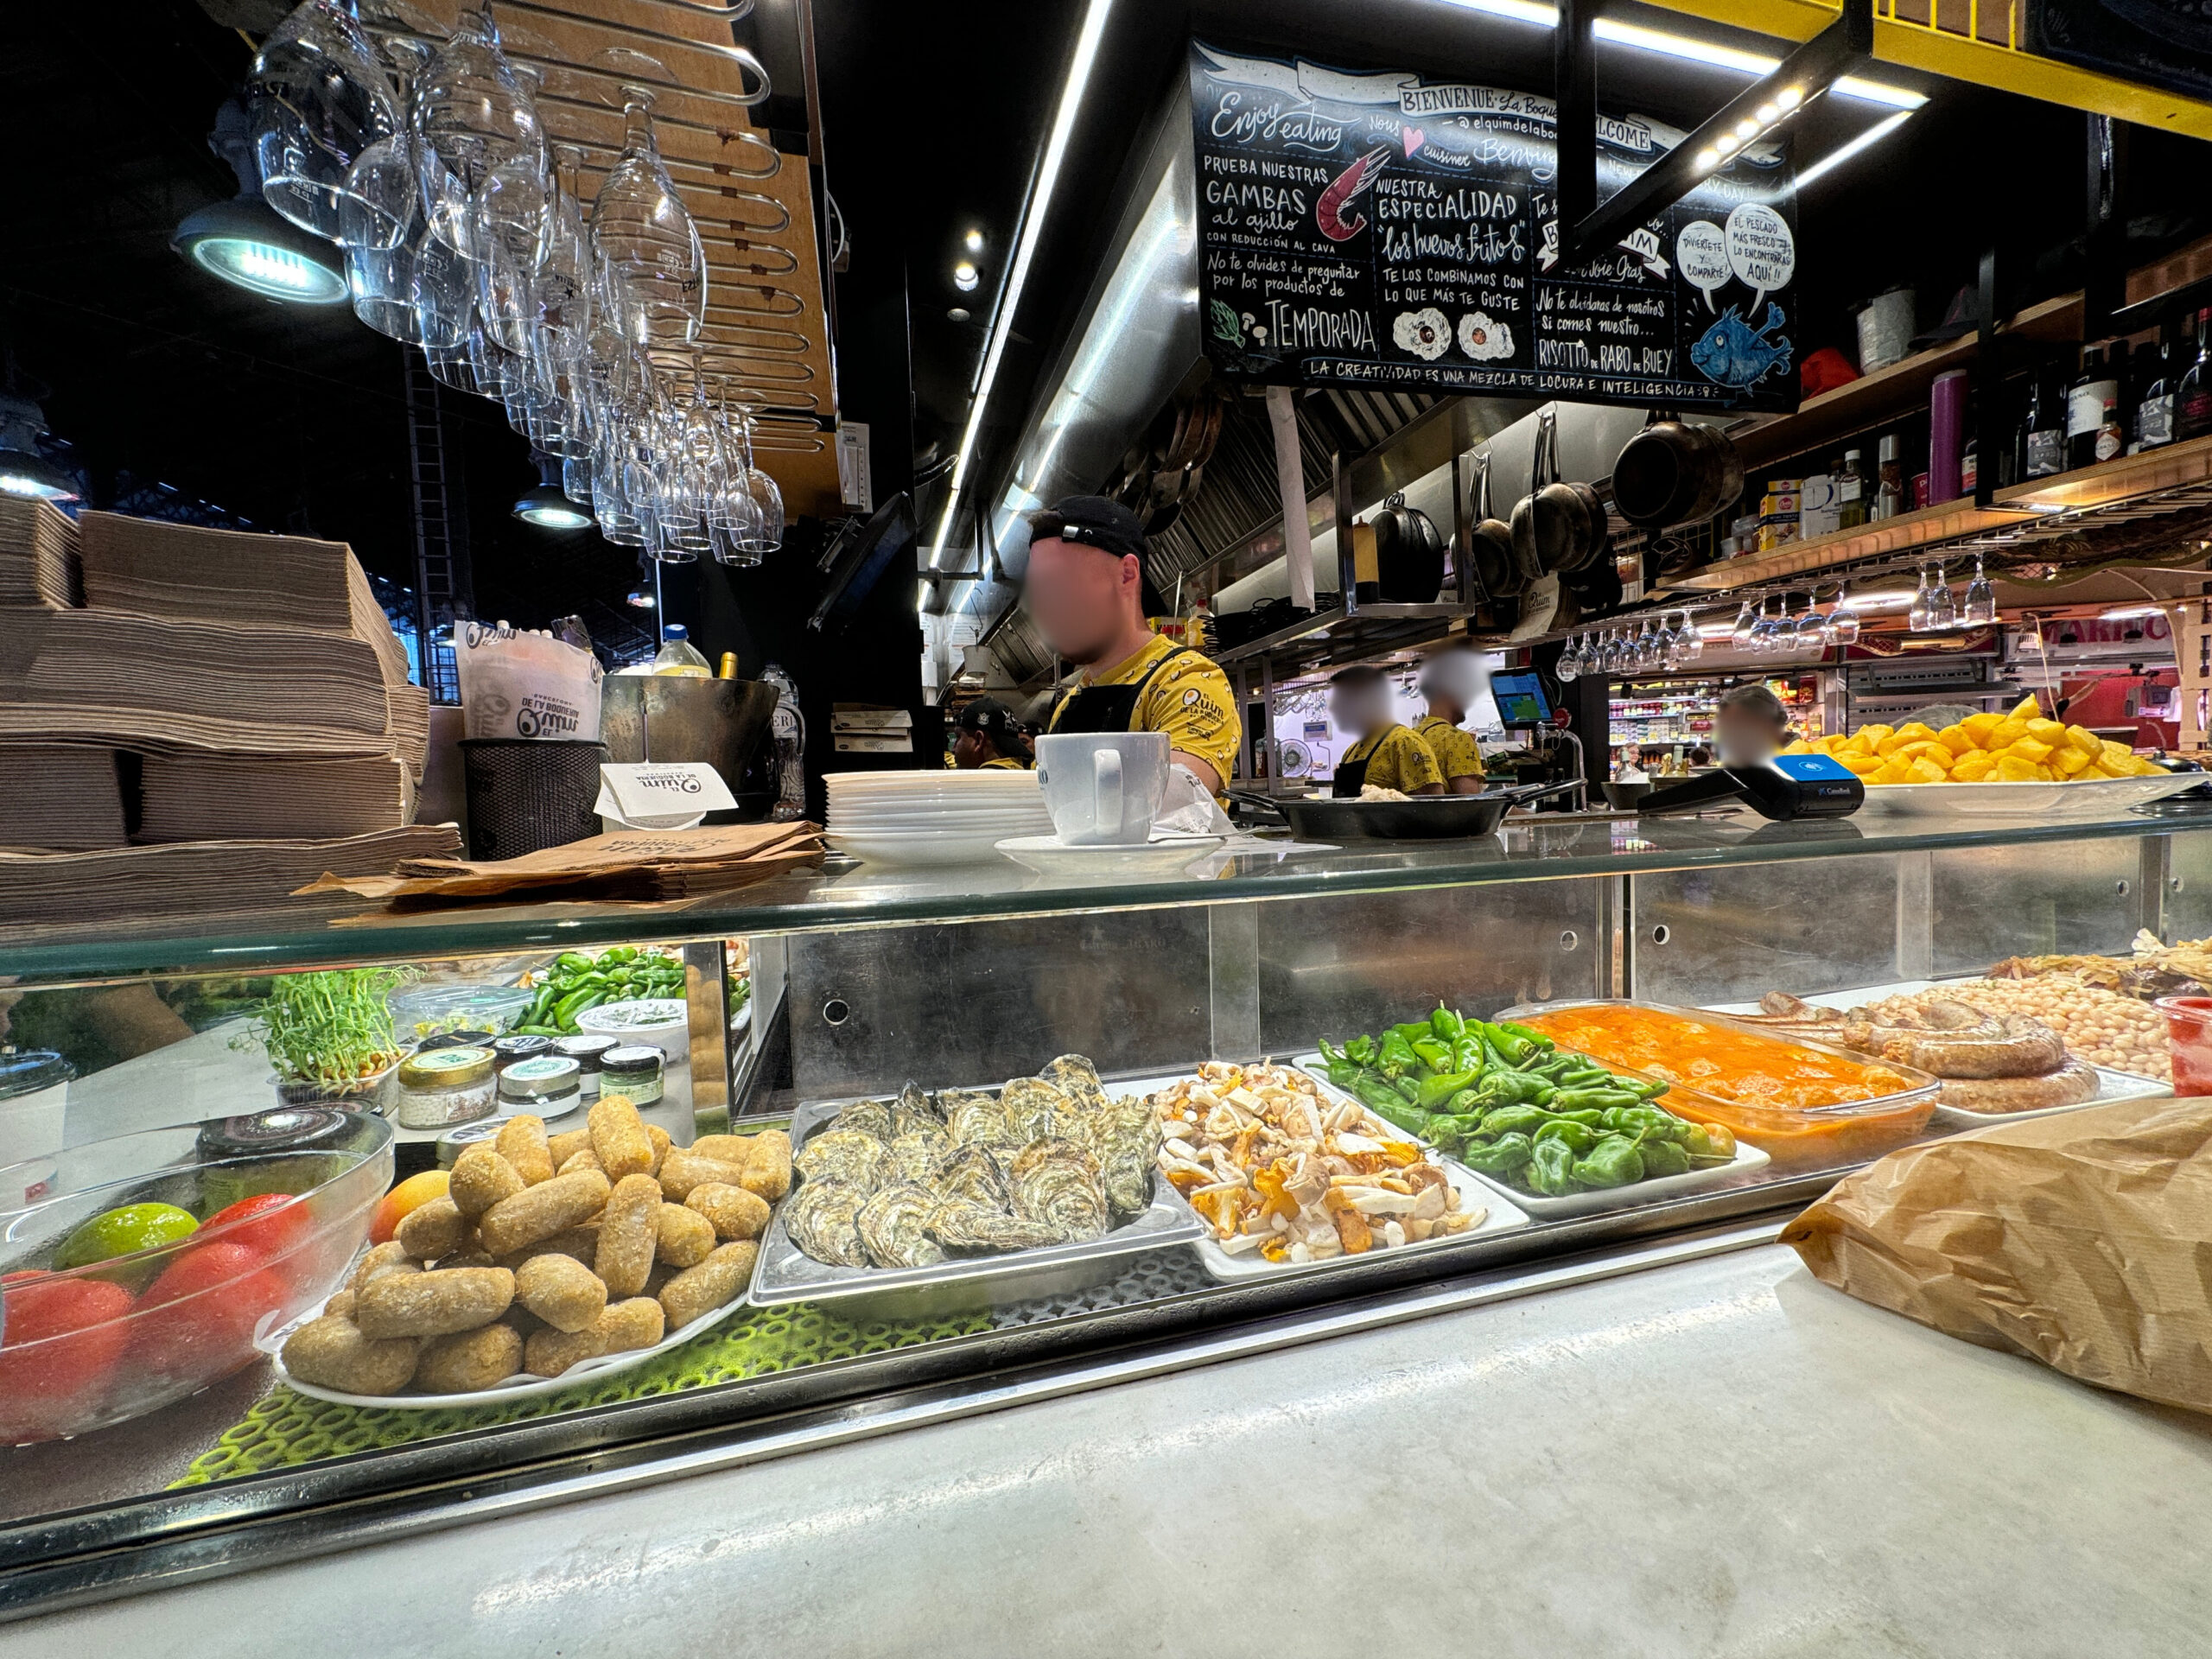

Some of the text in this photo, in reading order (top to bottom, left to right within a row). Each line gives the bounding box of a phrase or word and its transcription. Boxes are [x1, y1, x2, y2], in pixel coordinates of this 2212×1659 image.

[1211, 92, 1342, 152] Enjoy eating
[1402, 87, 1649, 149] BIENVENUE La Boque LCOME
[1458, 116, 1557, 139] @elquimdelabo
[1369, 116, 1471, 167] Nous cuisiner
[1204, 155, 1329, 187] PRUEBA NUESTRAS
[1473, 138, 1558, 181] Benving
[1206, 180, 1306, 215] GAMBAS
[1376, 179, 1443, 200] NUESTRA
[1378, 188, 1517, 220] ESPECIALIDAD
[1212, 207, 1299, 233] al ajillo
[1734, 217, 1778, 234] EL PESCADO
[1207, 232, 1227, 242] CON
[1294, 241, 1306, 251] AL
[1312, 243, 1336, 254] CAVA
[1413, 222, 1465, 260] huevos
[1733, 231, 1776, 248] MÁS FRESCO
[1733, 245, 1743, 256] LO
[1207, 251, 1360, 285] No te olvides de preguntar
[1382, 268, 1524, 289] TE LOS COMBINAMOS CON
[1213, 271, 1345, 297] por los productos de
[1384, 287, 1521, 311] LO QUE MÁS TE GUSTE
[1535, 286, 1554, 312] No
[1555, 288, 1566, 310] te
[1612, 294, 1623, 312] de
[1626, 297, 1665, 317] nosotros
[1264, 299, 1376, 353] TEMPORADA
[1556, 317, 1592, 333] comes
[1539, 338, 1674, 376] RISOTTO DE RABO DE BUEY
[1311, 360, 1330, 374] LA
[1426, 369, 1439, 382] ES
[1443, 370, 1465, 383] UNA
[1469, 372, 1516, 385] MEZCLA
[1521, 375, 1535, 386] DE
[1540, 377, 1584, 390] LOCURA
[1588, 378, 1597, 391] E
[1602, 381, 1694, 396] INTELIGENCIA
[1182, 688, 1224, 719] Quim
[771, 715, 793, 727] ERI
[639, 778, 702, 794] Quim
